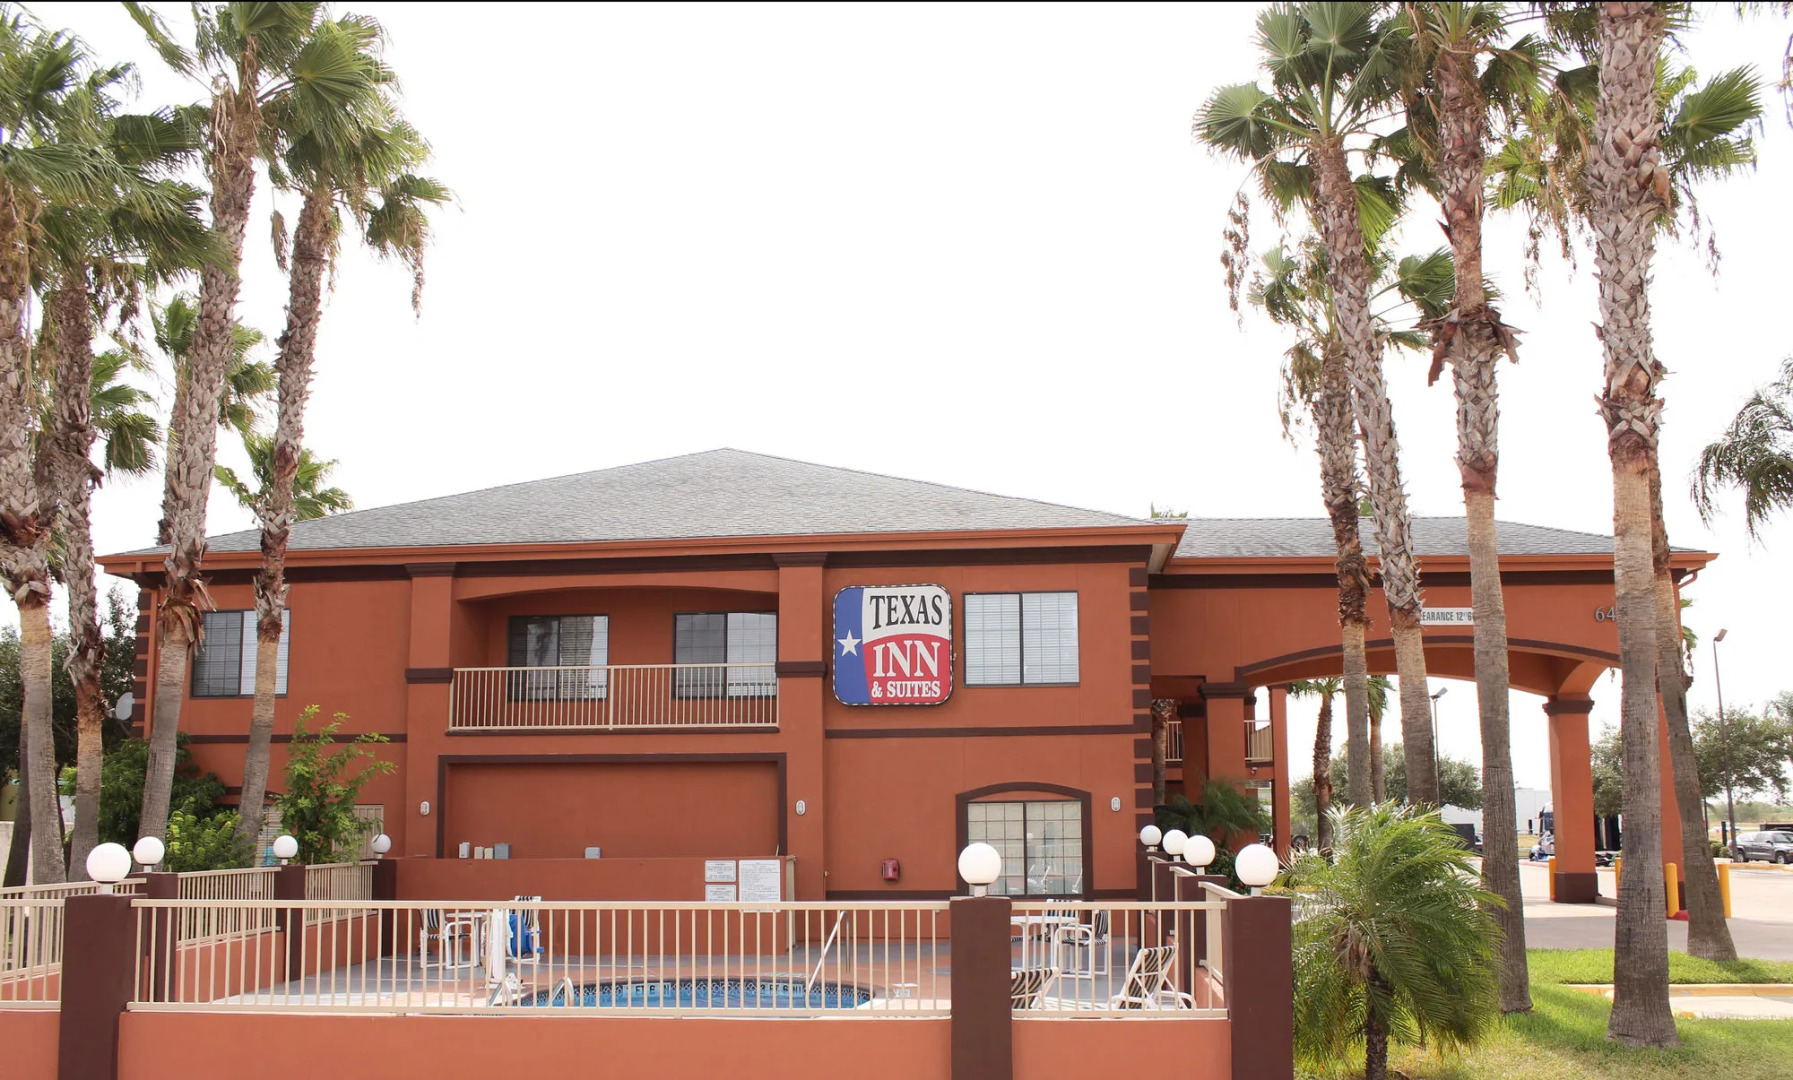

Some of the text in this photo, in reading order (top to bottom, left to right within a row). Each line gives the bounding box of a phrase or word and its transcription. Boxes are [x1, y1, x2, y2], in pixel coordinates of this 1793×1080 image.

[870, 594, 943, 630] TEXAS
[1420, 611, 1454, 621] EARANCE
[873, 640, 940, 677] INN
[871, 681, 941, 698] & SUITES
